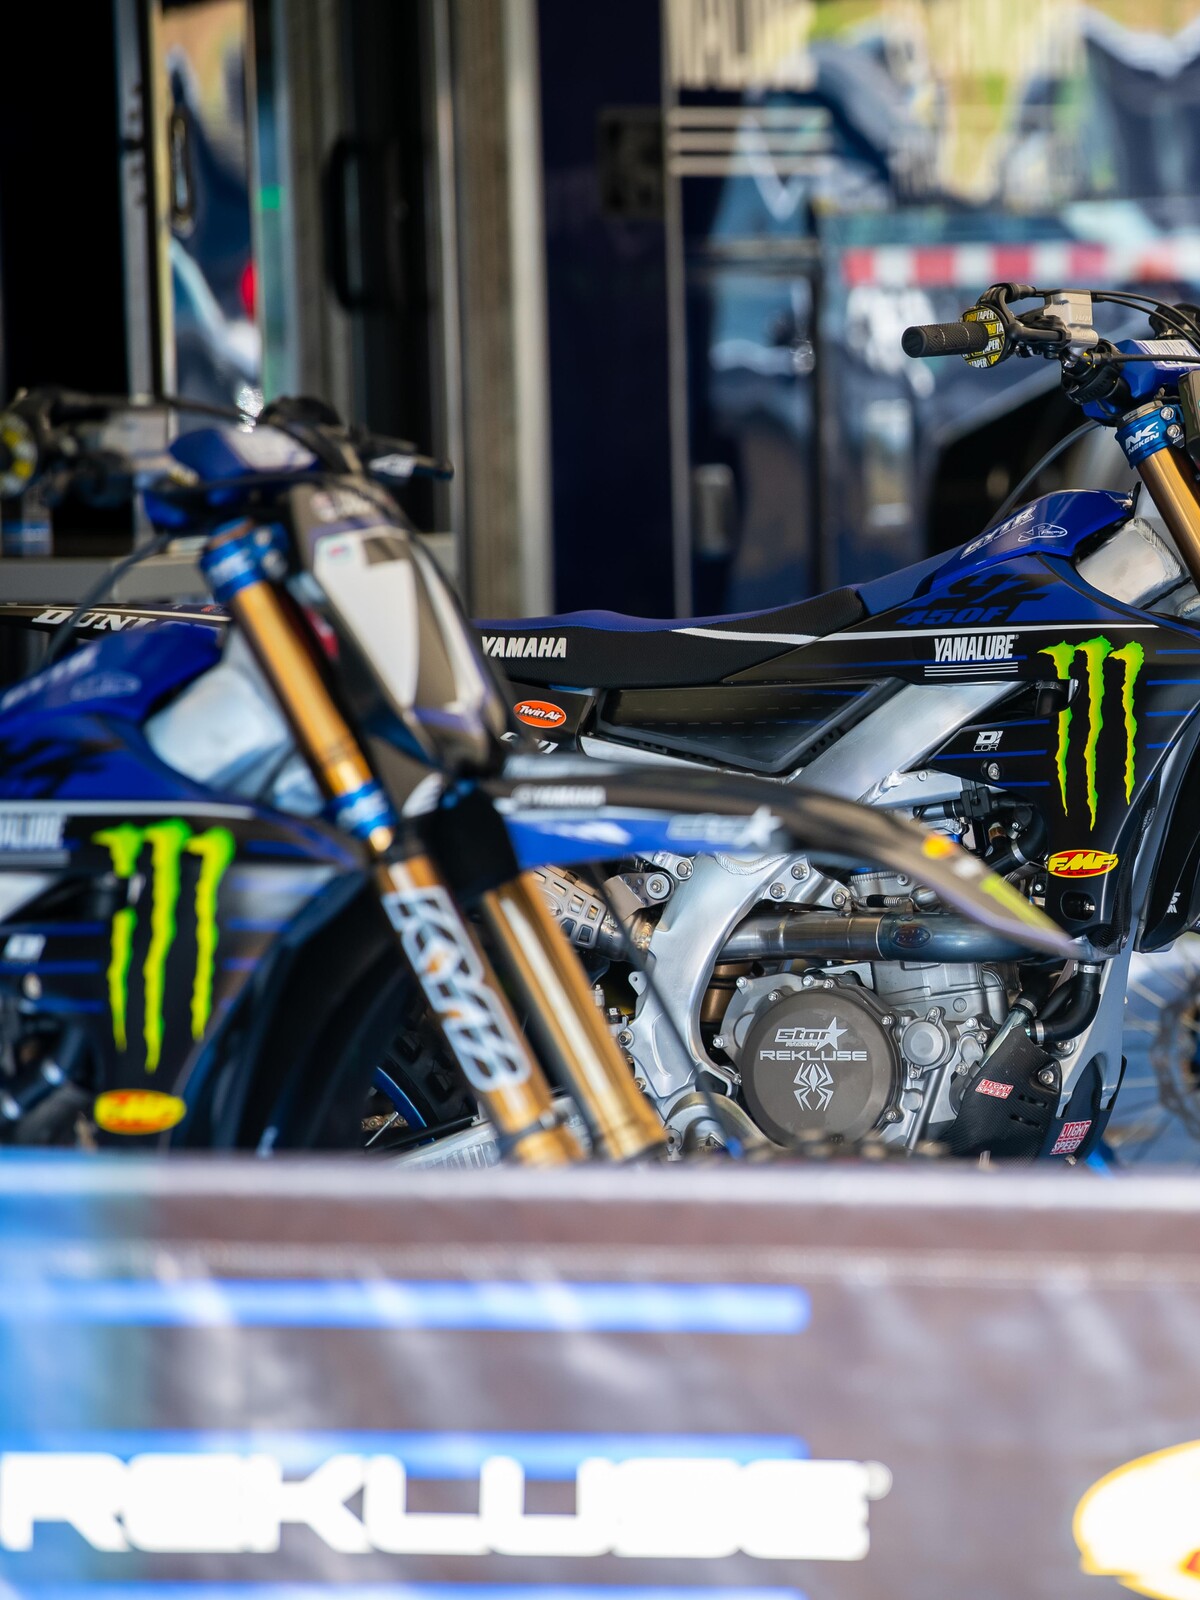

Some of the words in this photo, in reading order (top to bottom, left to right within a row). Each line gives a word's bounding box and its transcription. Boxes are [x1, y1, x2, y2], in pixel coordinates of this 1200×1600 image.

[482, 636, 567, 658] YAMAHA
[519, 705, 545, 717] Twin
[545, 711, 563, 722] Air
[1048, 853, 1118, 872] FMF
[760, 1050, 868, 1061] REKLUSE
